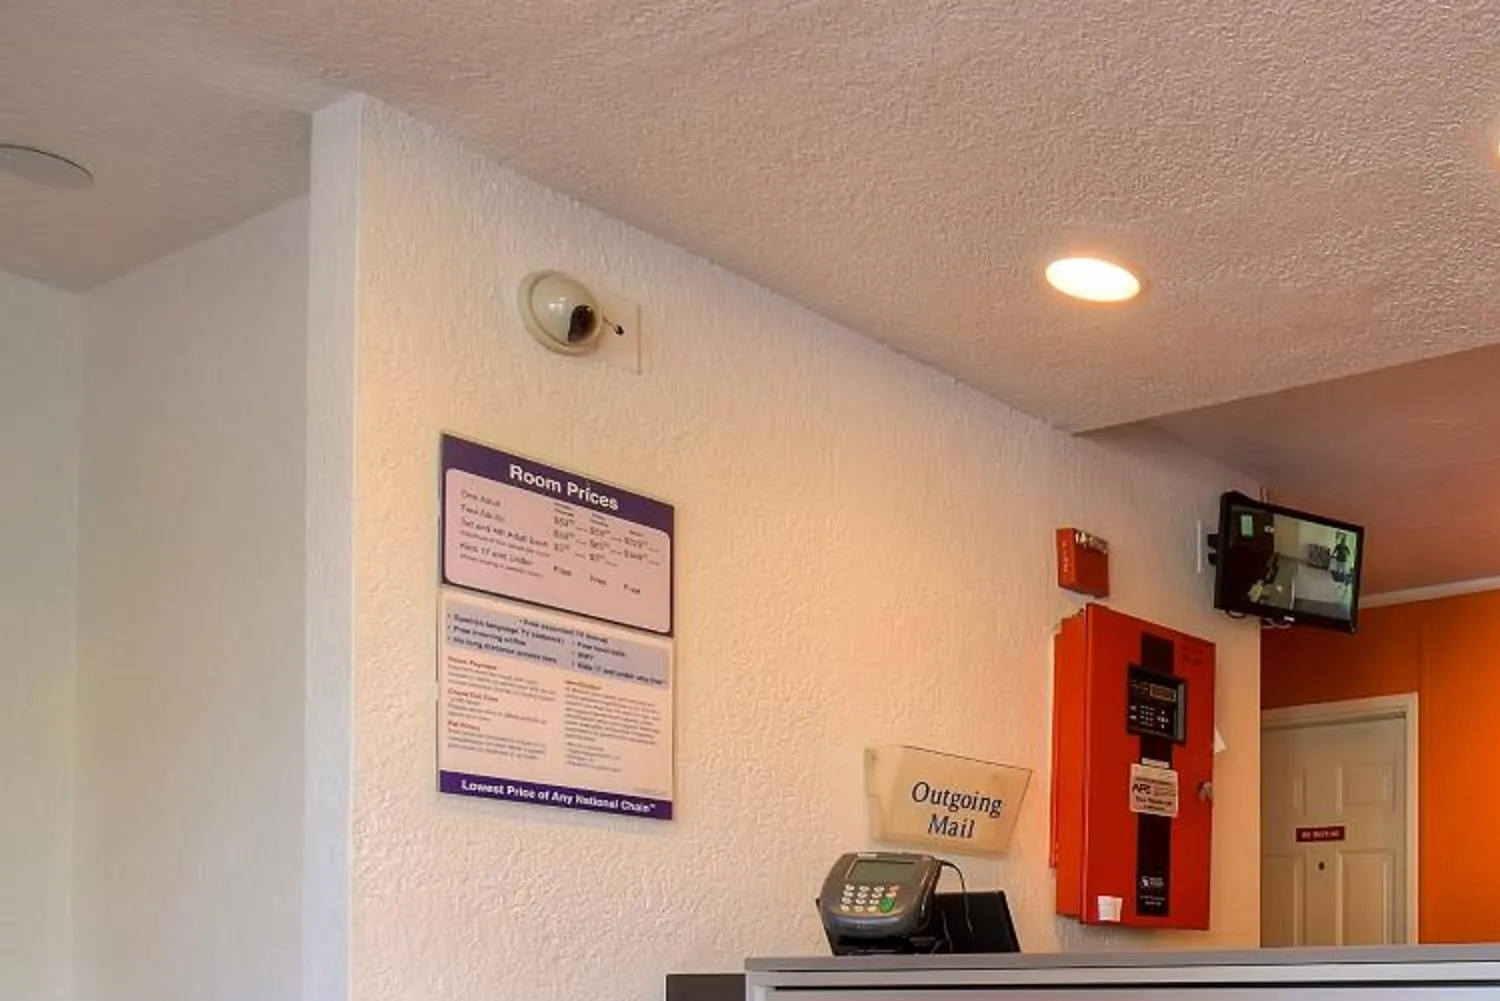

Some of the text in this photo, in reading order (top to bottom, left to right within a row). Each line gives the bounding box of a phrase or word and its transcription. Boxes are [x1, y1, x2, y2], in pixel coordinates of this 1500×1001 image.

[509, 464, 561, 493] Room
[567, 481, 619, 511] Prices
[461, 779, 504, 795] Lowest
[507, 785, 535, 799] Price
[538, 791, 549, 801] of
[552, 792, 573, 804] Any
[575, 796, 618, 809] National
[911, 781, 1002, 818] Outgoing
[927, 813, 975, 839] Mail
